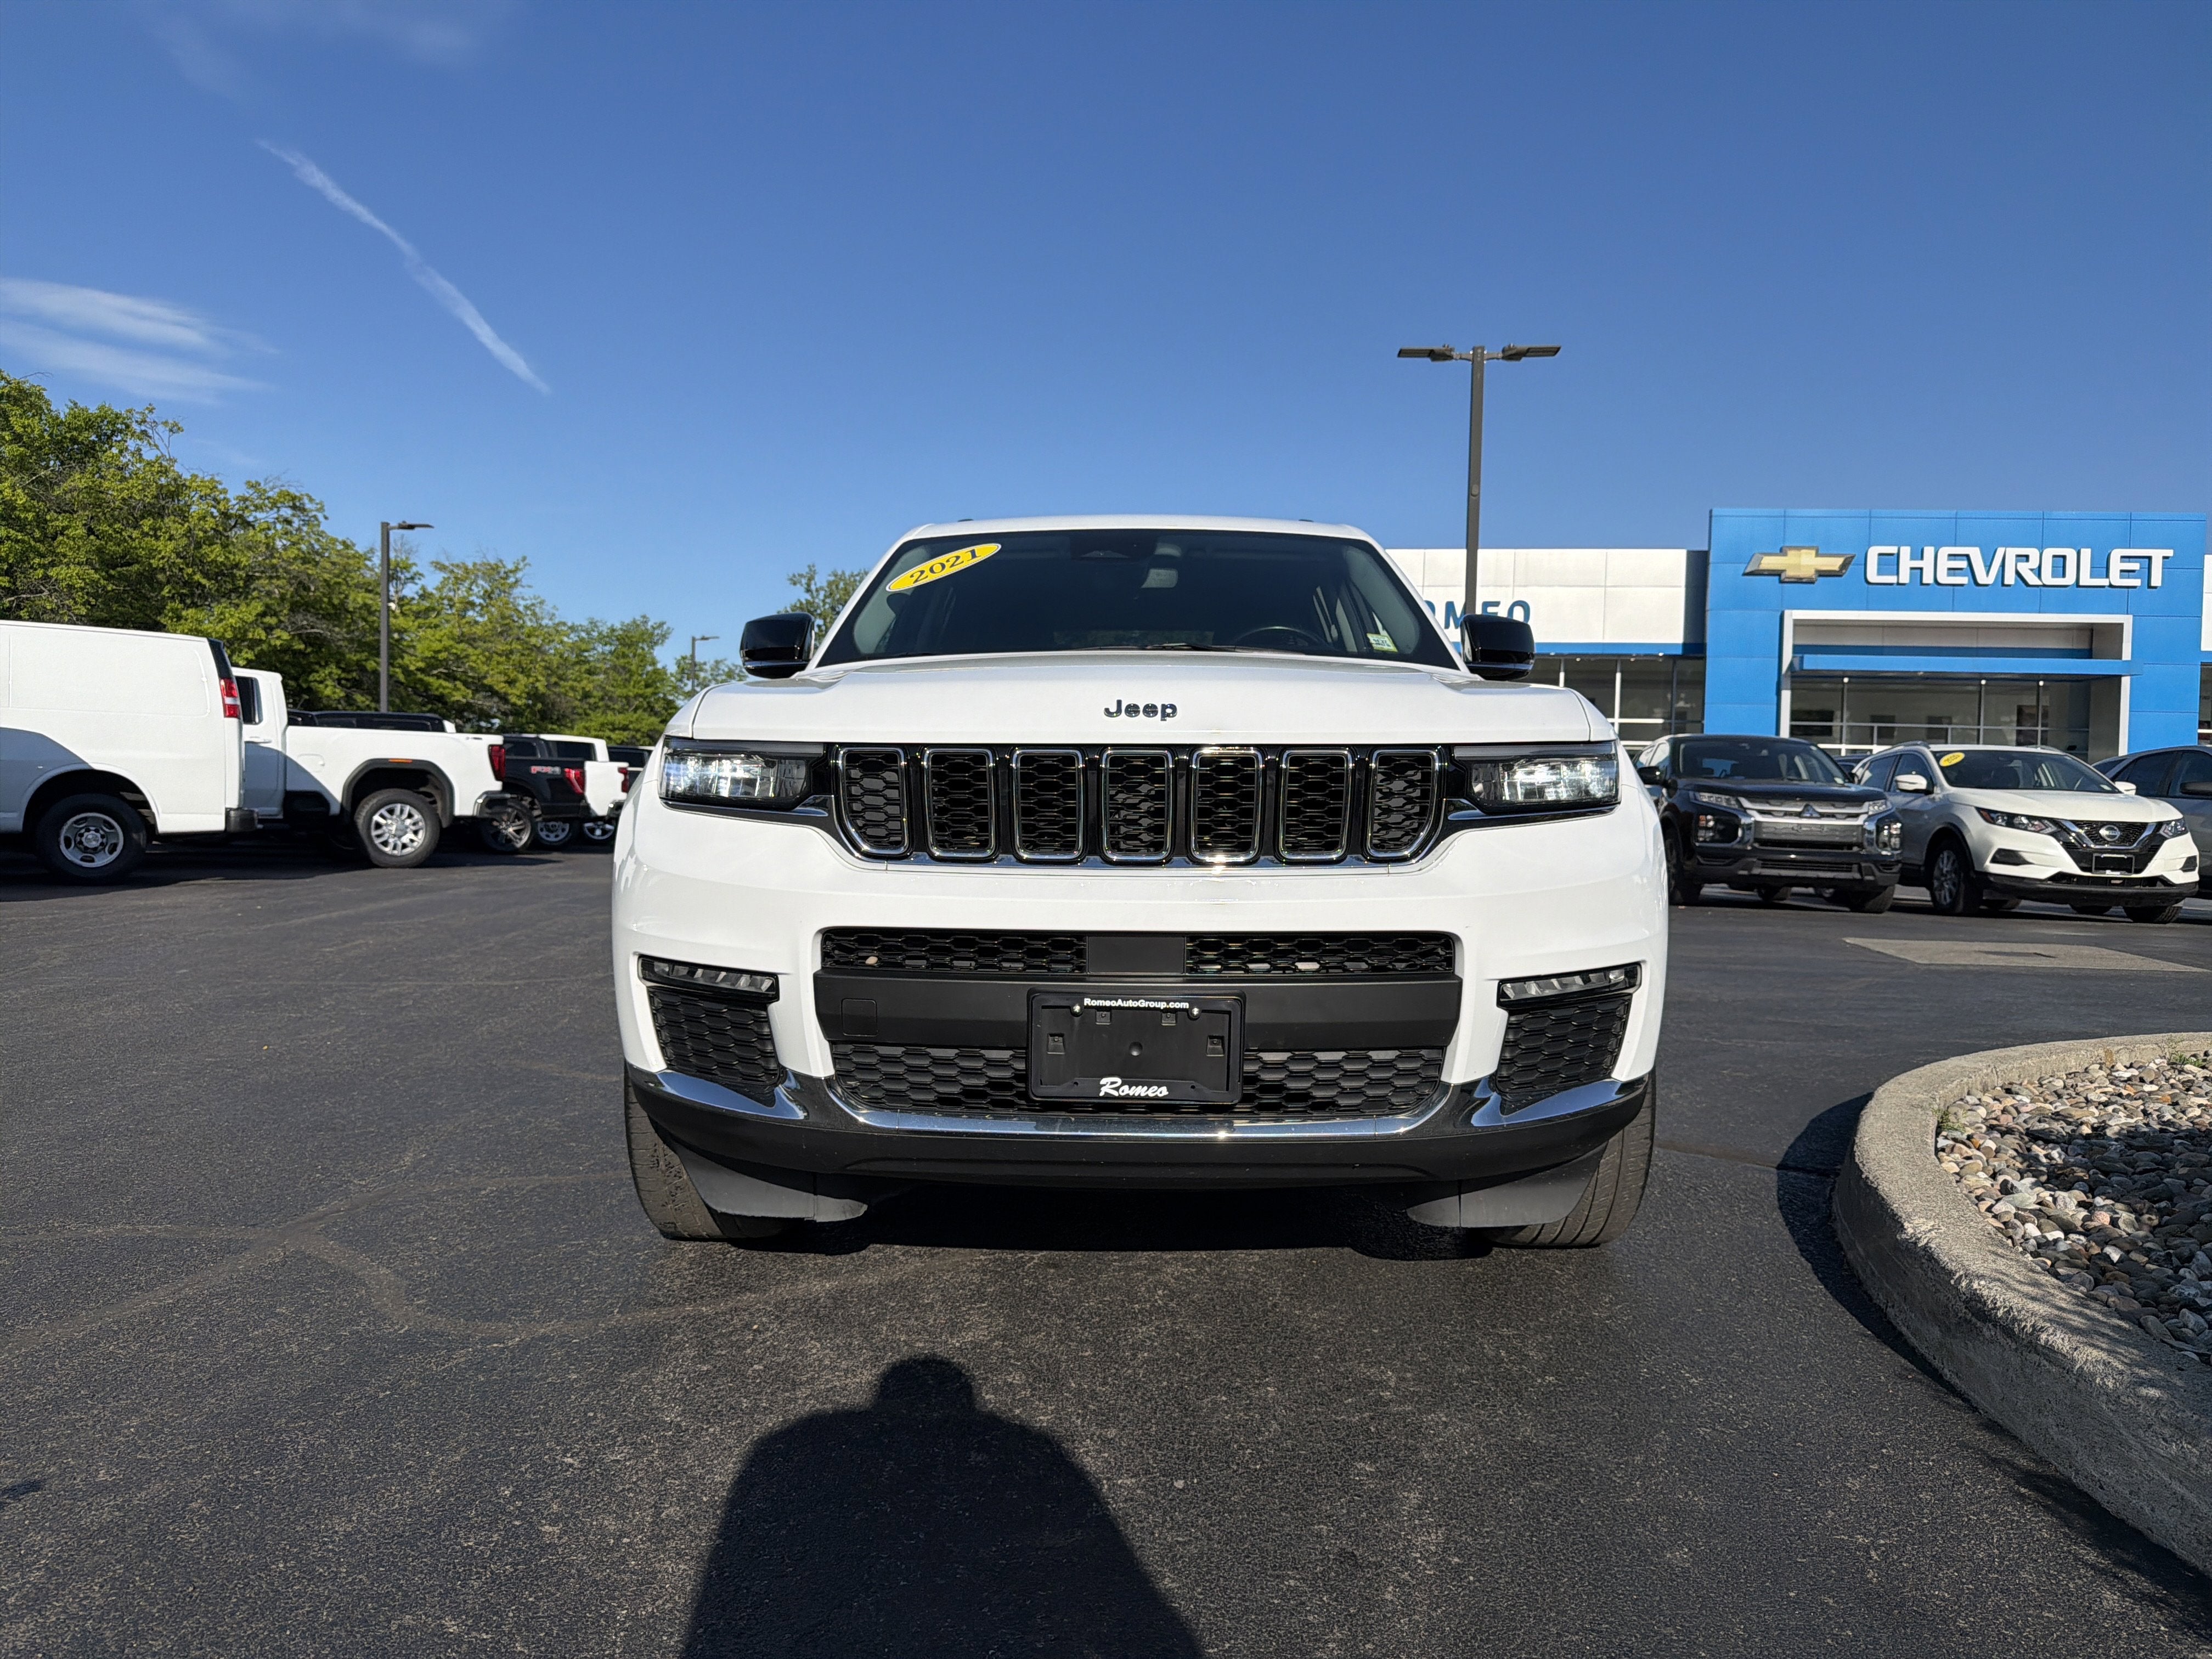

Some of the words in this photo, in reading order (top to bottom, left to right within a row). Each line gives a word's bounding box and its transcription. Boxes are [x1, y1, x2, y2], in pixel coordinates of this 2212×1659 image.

[909, 549, 981, 584] 2021
[1866, 545, 2174, 588] CHEVROLET
[1104, 699, 1177, 721] Jeep
[1084, 998, 1189, 1009] RomeoAutoGroup.com
[1099, 1077, 1169, 1097] Romeo
